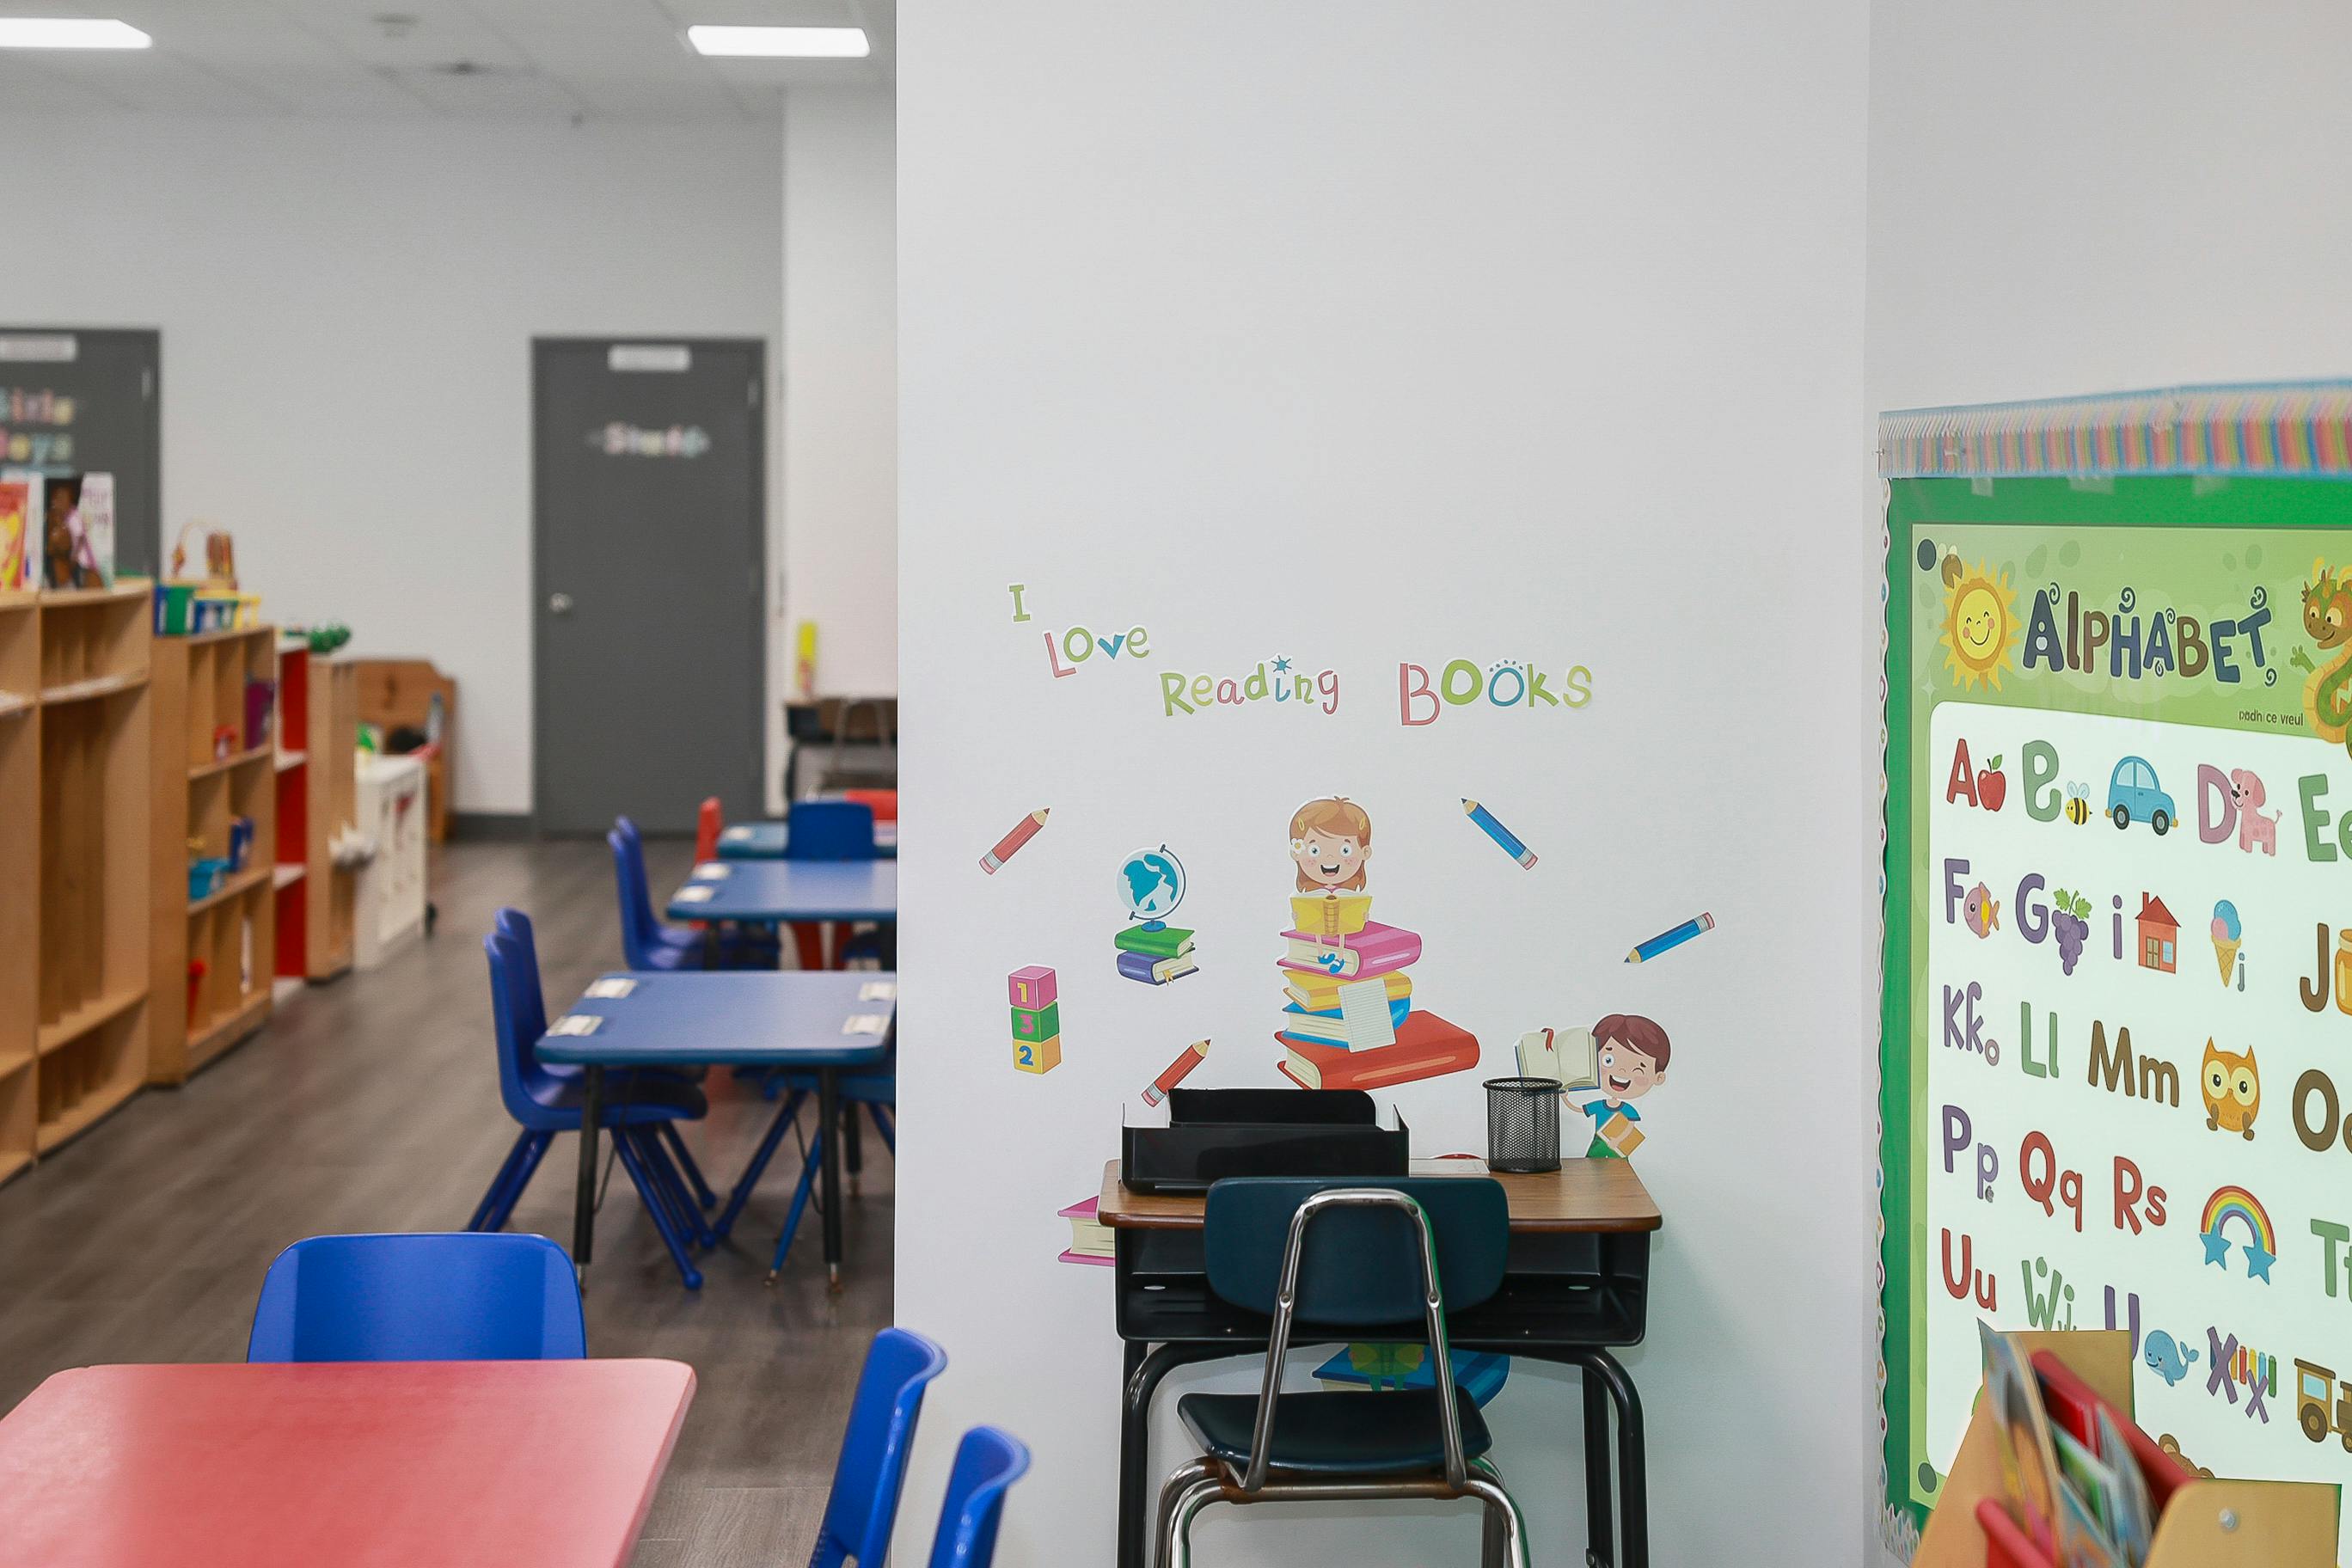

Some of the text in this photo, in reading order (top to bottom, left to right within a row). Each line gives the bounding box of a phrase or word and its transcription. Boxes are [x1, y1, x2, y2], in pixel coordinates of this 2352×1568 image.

[1008, 584, 1031, 622] I
[1160, 655, 1338, 717] Reading
[1947, 738, 1978, 807] A
[2016, 873, 2048, 944] G
[2300, 922, 2330, 1012] J
[1017, 983, 1027, 1003] 1
[1019, 1014, 1034, 1035] 3
[1019, 1045, 1034, 1066] 2
[2088, 1020, 2180, 1108] Mm
[2019, 1130, 2083, 1233] Qq
[1942, 1228, 1997, 1313] Uu
